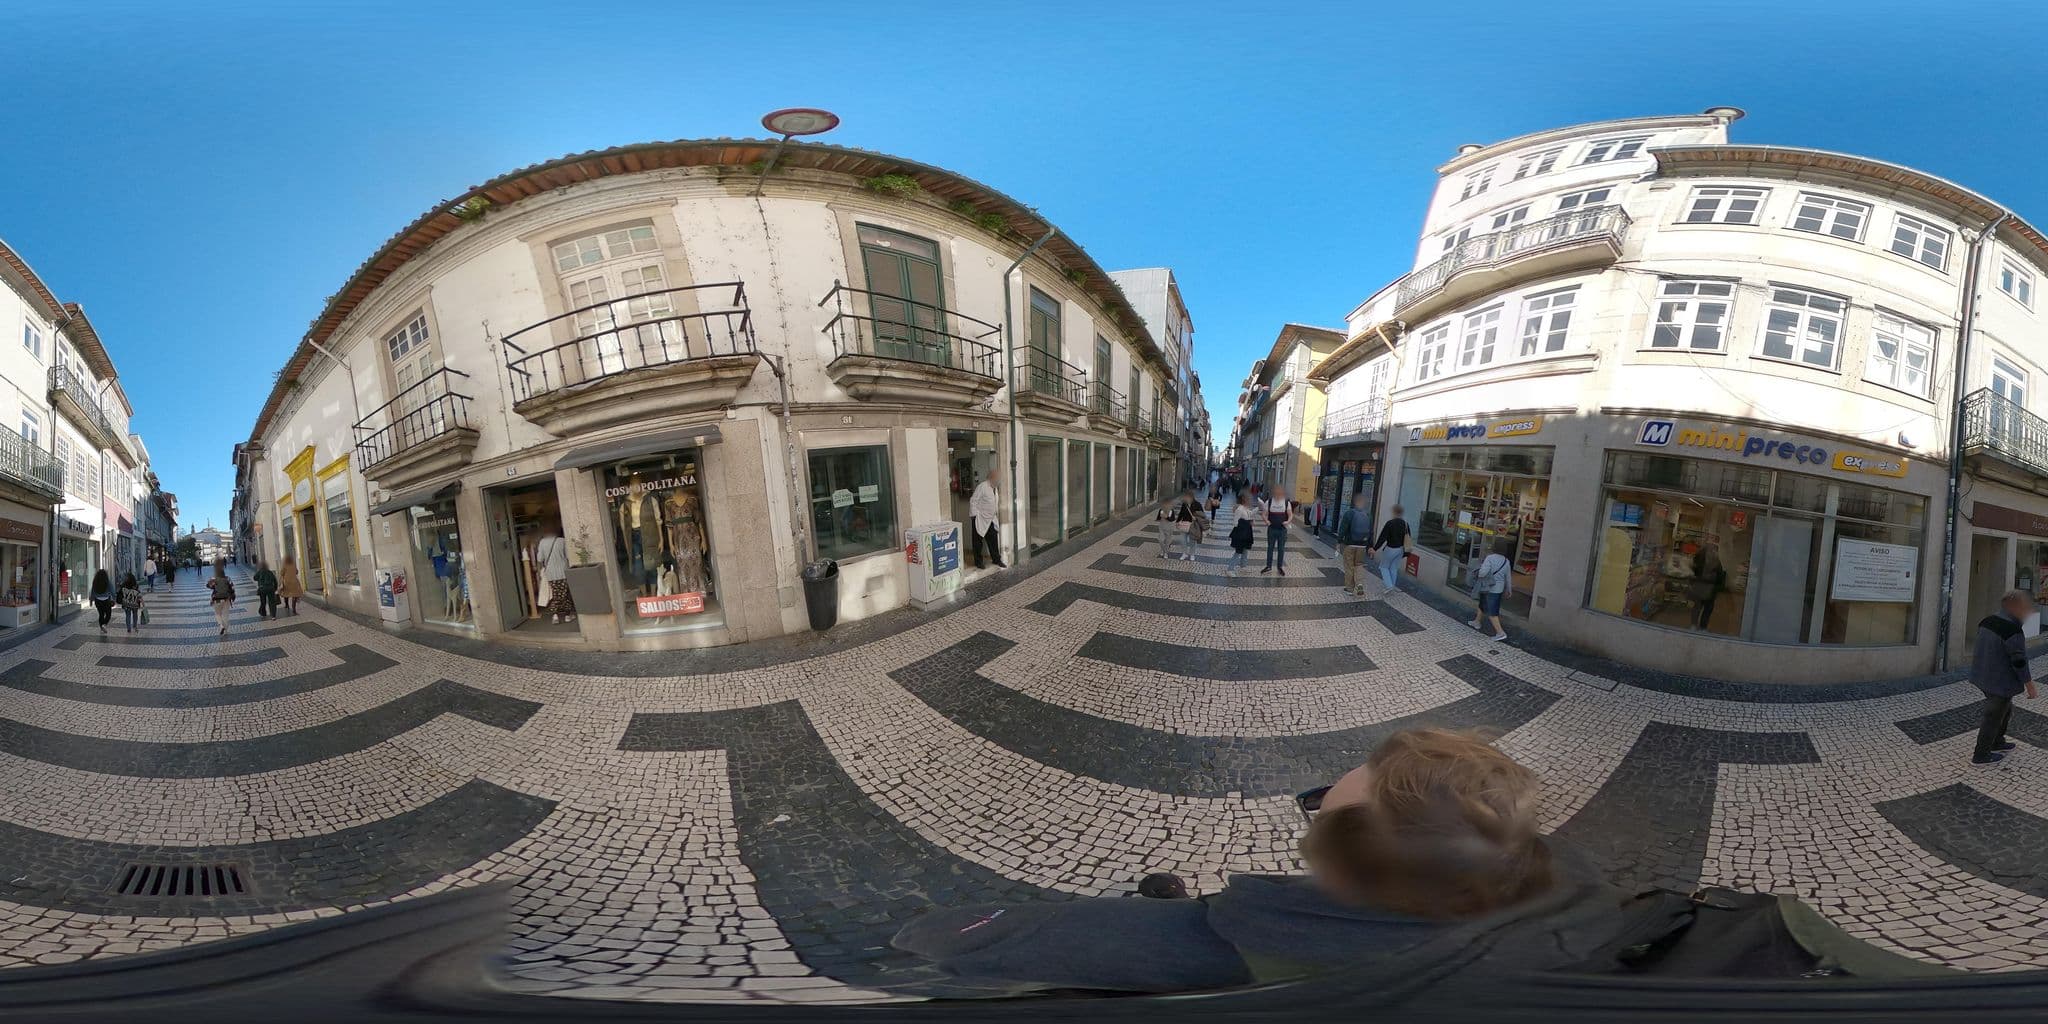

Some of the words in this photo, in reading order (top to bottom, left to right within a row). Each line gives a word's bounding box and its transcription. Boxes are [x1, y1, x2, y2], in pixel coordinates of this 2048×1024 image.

[1423, 424, 1486, 441] minipreço
[1494, 421, 1535, 433] express
[1678, 426, 1828, 465] minipreço
[1844, 455, 1902, 473] expess
[605, 475, 697, 498] COSMOPOLITANA
[1870, 547, 1890, 555] AVISO
